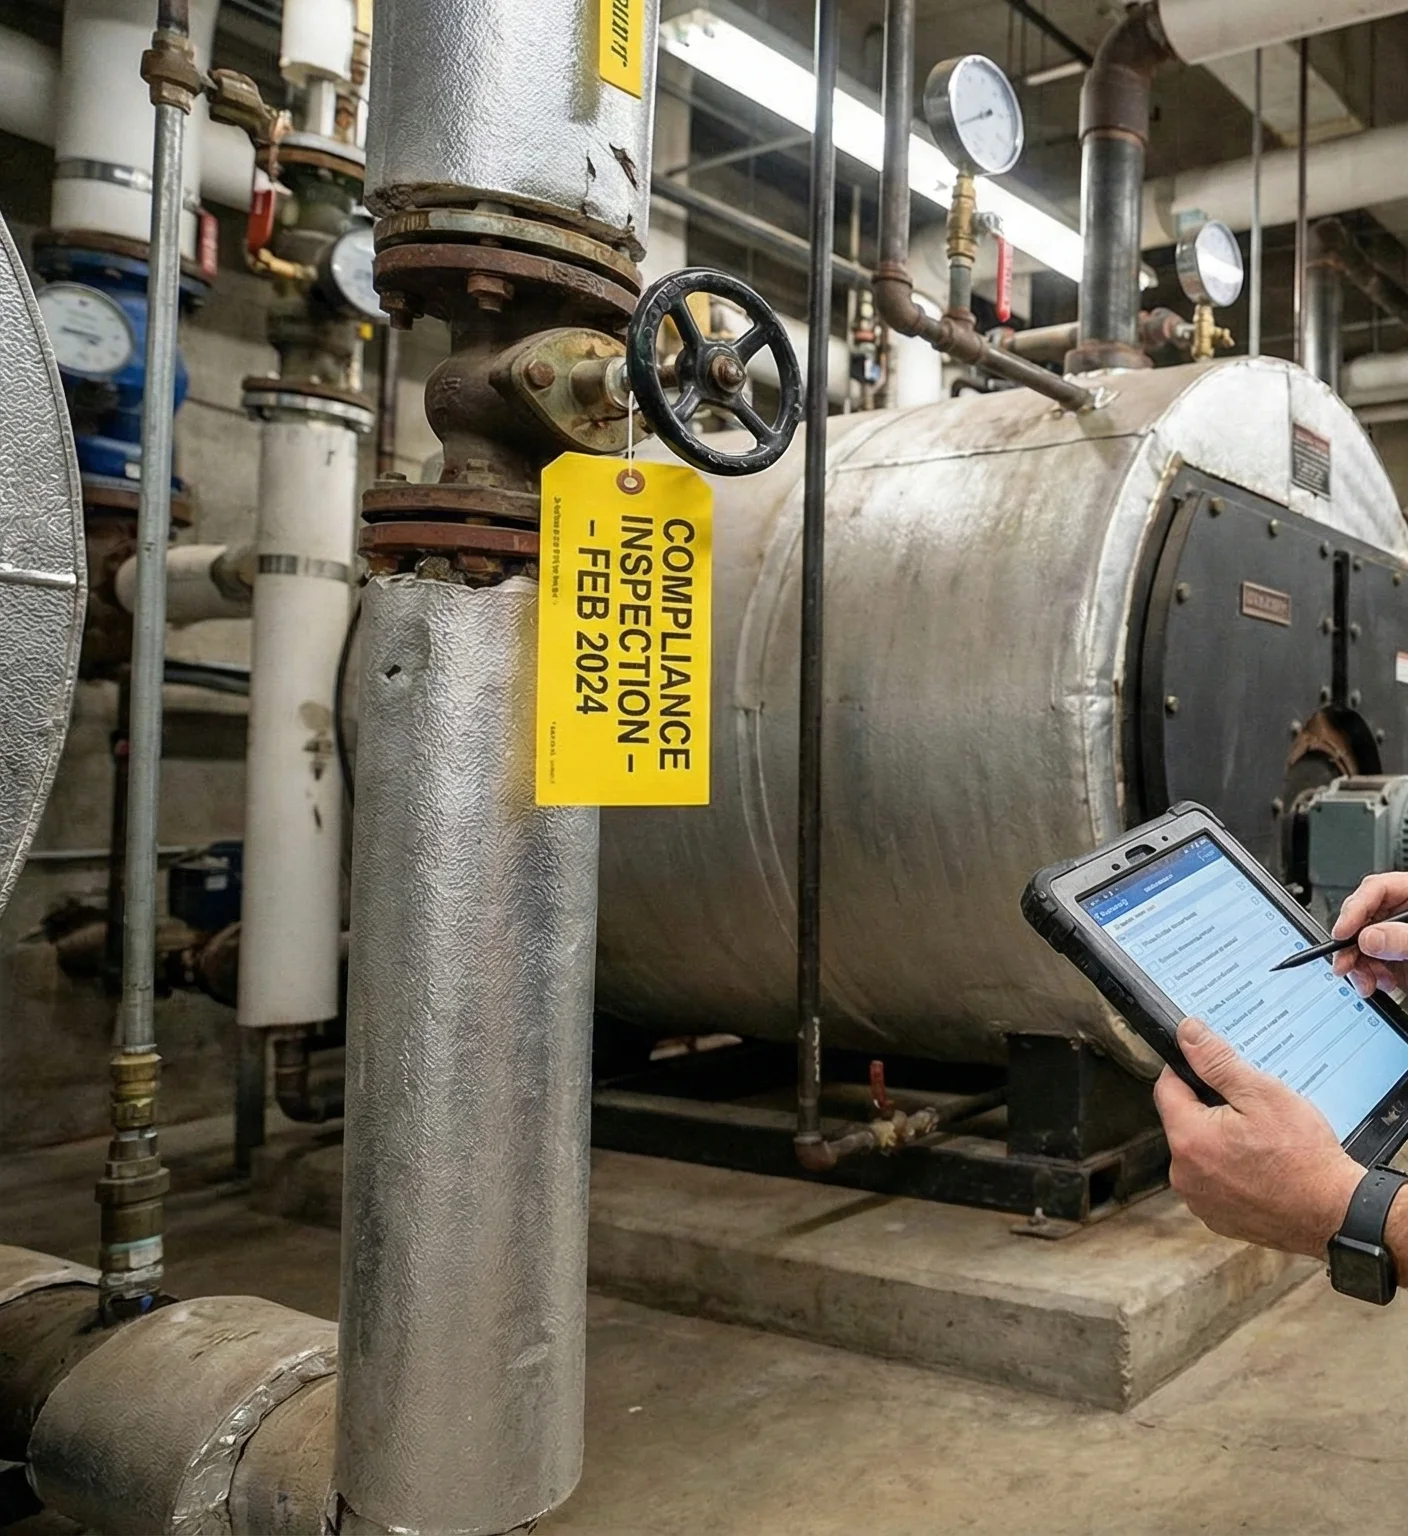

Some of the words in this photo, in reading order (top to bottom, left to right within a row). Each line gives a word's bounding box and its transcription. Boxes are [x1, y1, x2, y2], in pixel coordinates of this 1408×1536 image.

[576, 546, 611, 620] FEB
[617, 514, 654, 745] INSPECTION
[658, 517, 696, 771] COMPLIANCE
[575, 629, 610, 716] 2024
